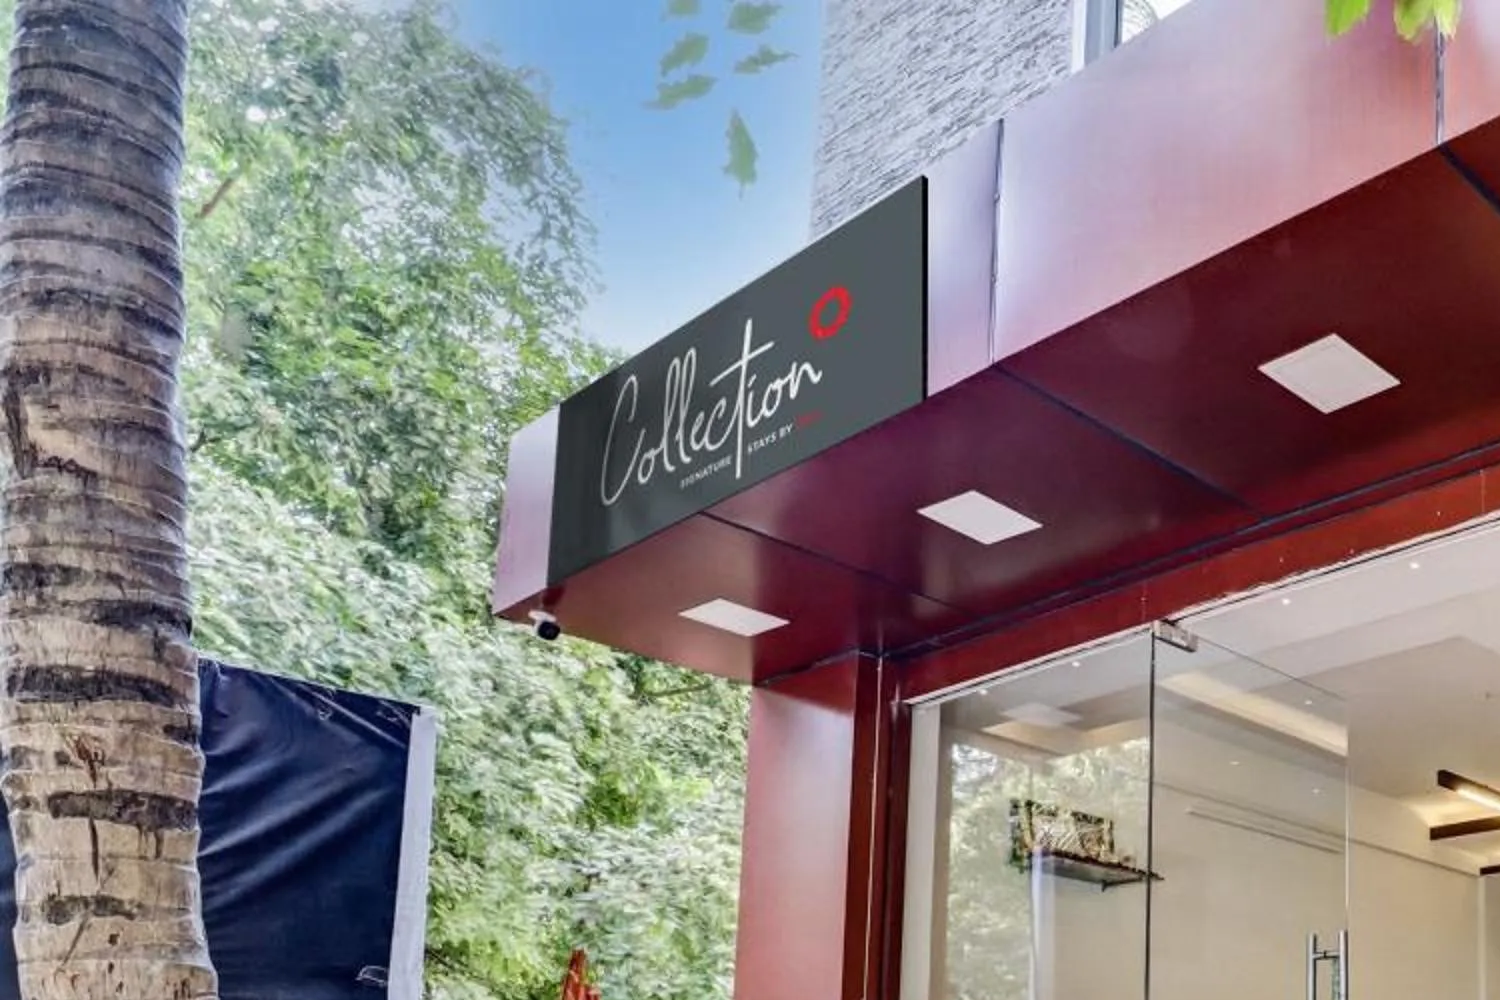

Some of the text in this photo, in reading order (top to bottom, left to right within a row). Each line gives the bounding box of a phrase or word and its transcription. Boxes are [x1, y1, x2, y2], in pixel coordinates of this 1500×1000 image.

[601, 318, 823, 506] Collection
[748, 432, 777, 454] STAYS
[779, 423, 794, 438] BY
